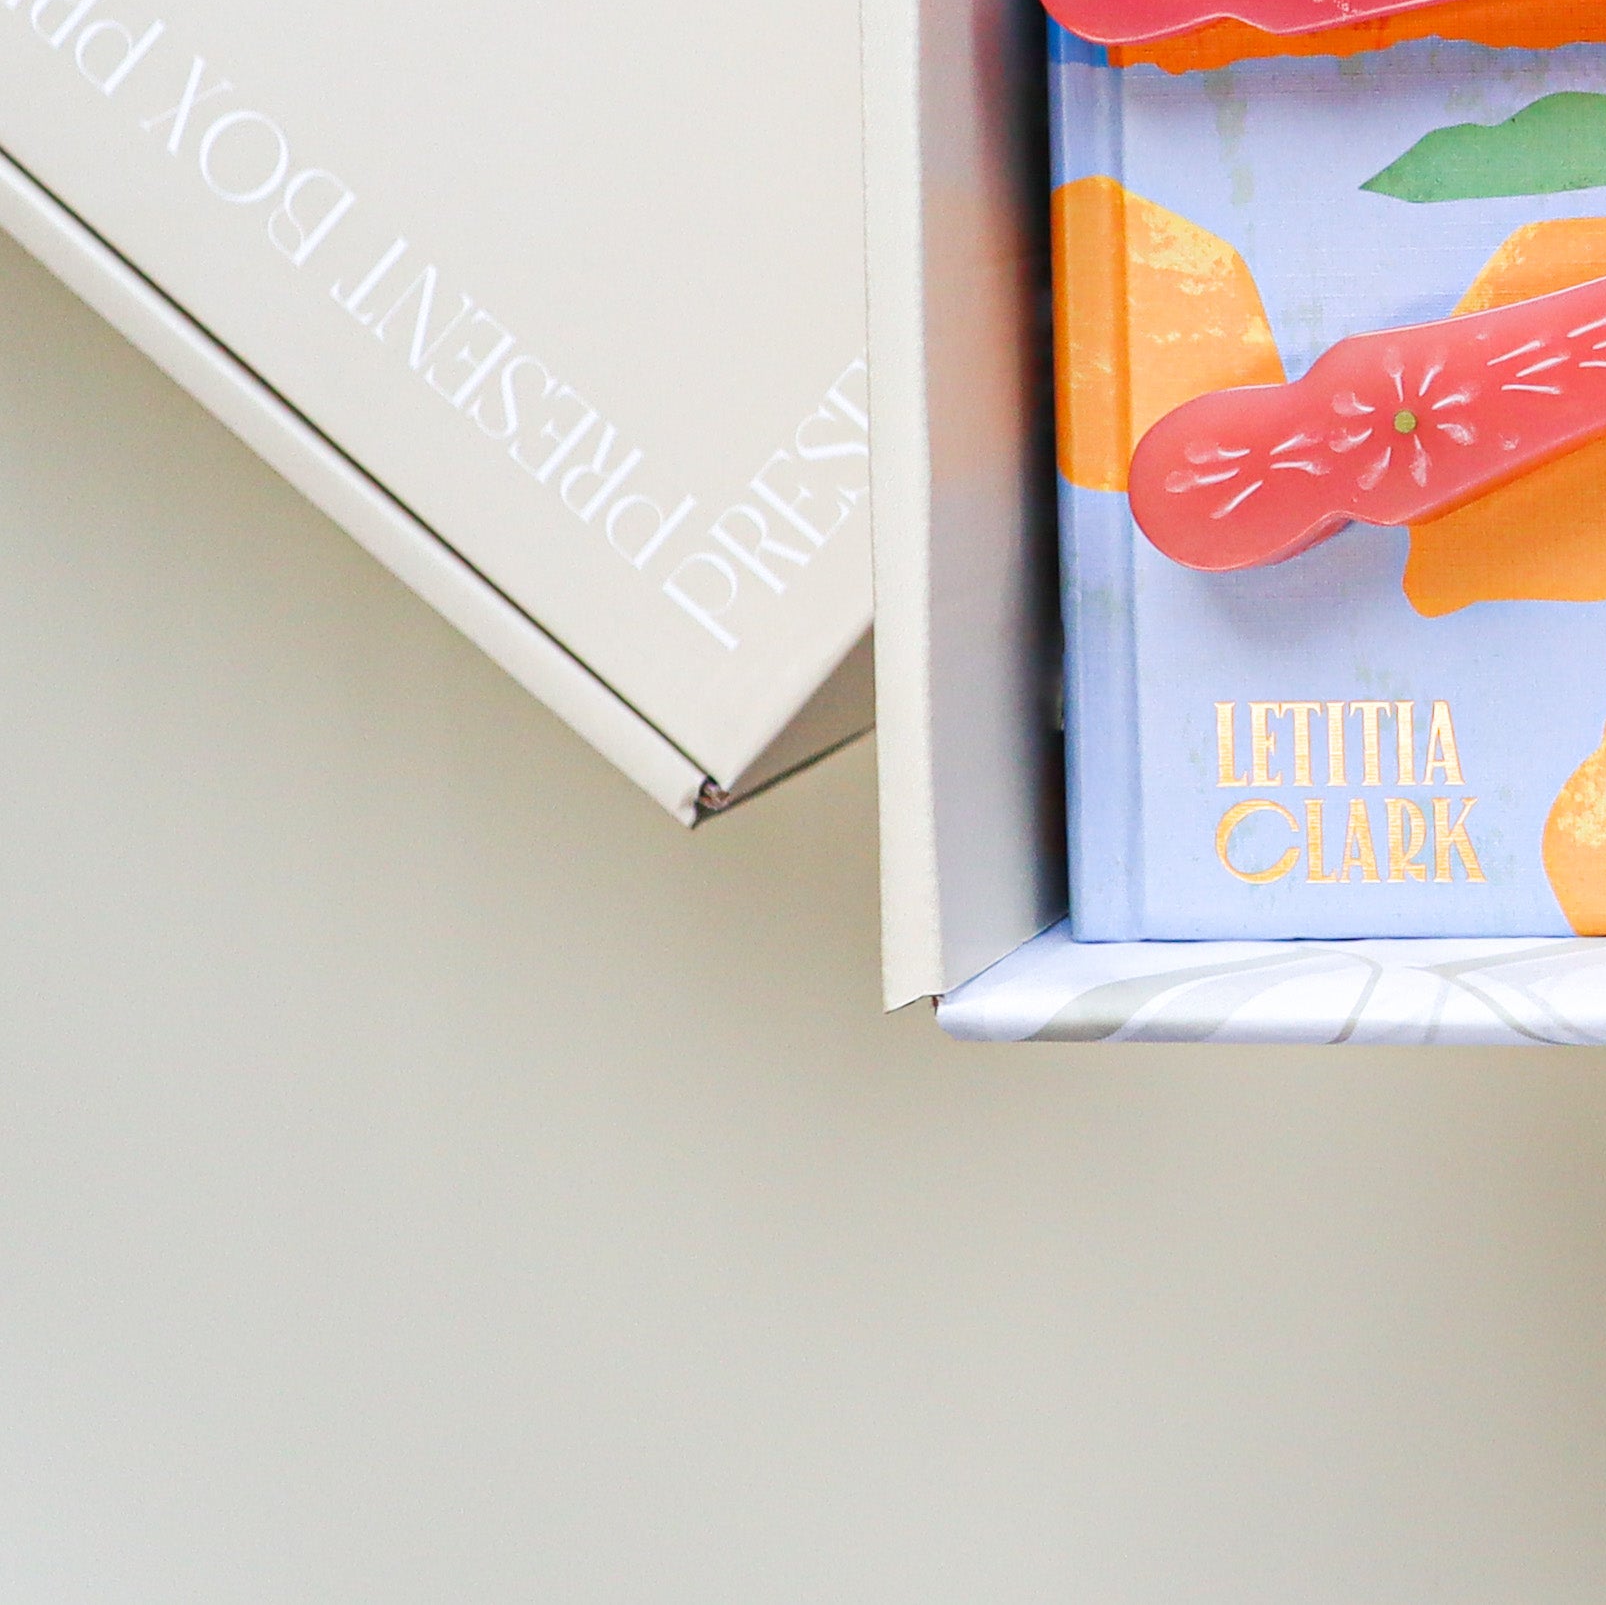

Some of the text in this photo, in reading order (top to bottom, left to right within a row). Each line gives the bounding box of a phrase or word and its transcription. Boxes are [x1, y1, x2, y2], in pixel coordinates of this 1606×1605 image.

[139, 54, 356, 268] BOX
[330, 234, 697, 571] PRESENT
[1213, 699, 1466, 787] LETITIA
[1214, 796, 1488, 884] CLARK
